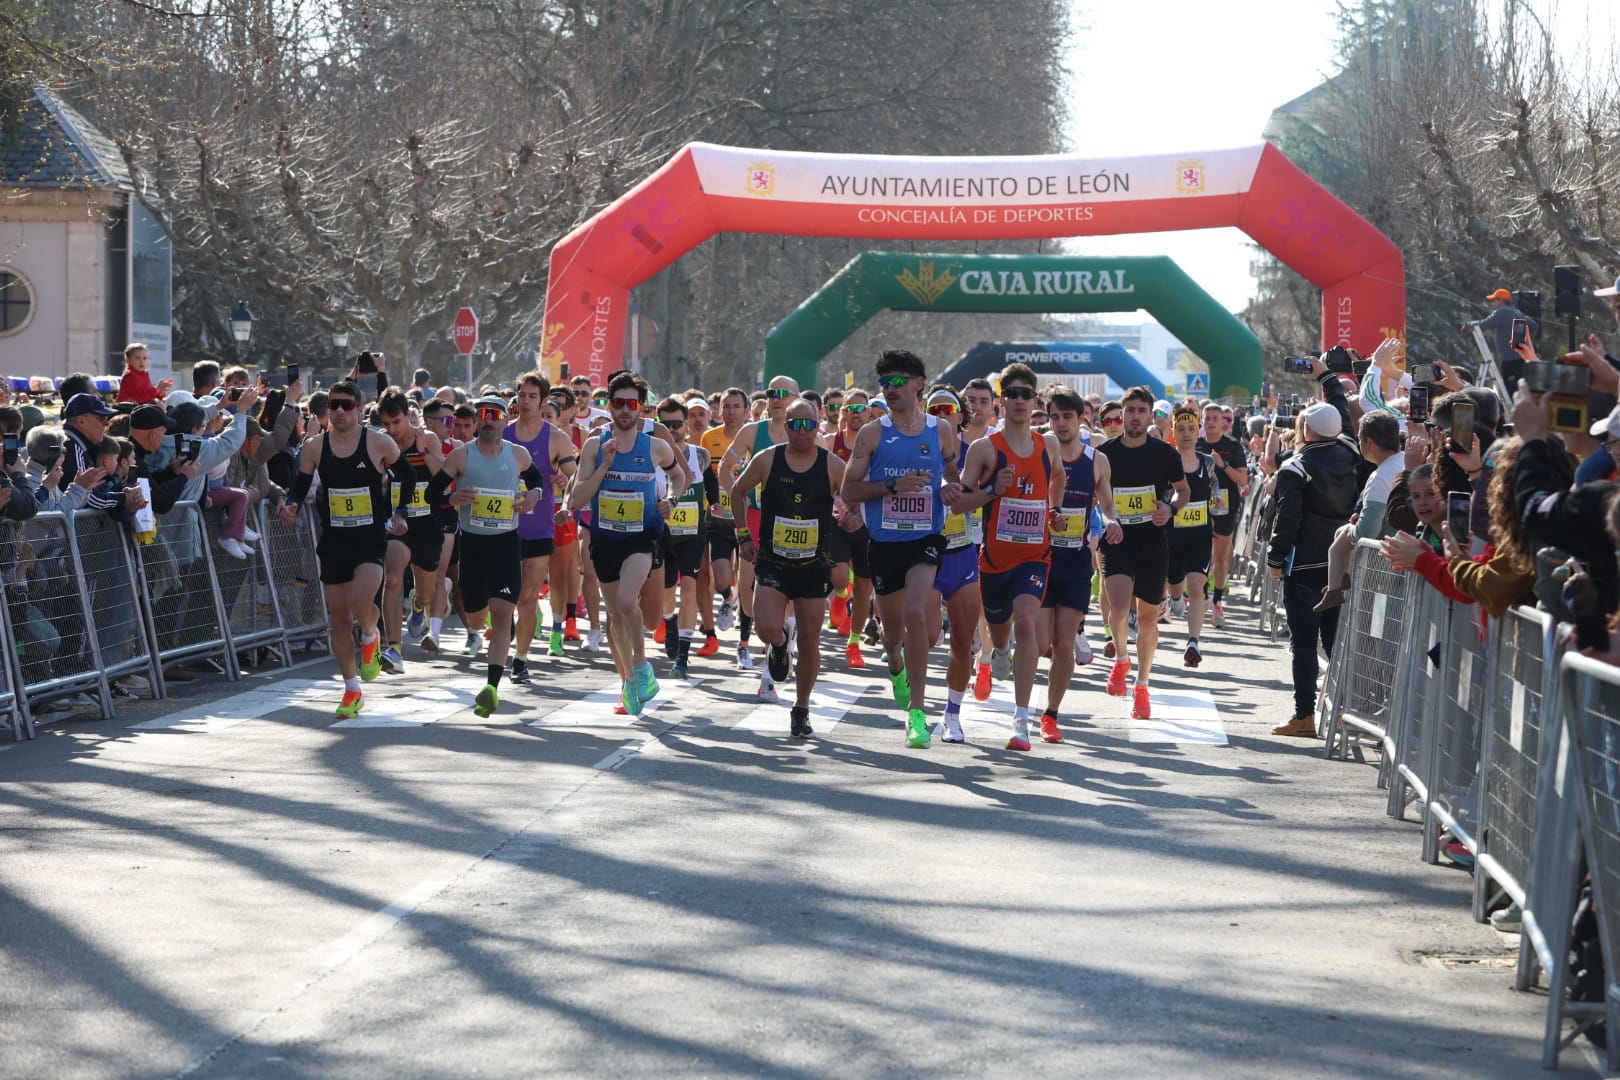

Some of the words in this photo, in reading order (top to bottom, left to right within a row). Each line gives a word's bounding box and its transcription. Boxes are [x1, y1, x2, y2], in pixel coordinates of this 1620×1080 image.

[821, 175, 1018, 197] AYUNTAMIENTO
[1027, 176, 1058, 196] DE
[1067, 169, 1130, 195] LEÓN
[858, 206, 967, 224] CONCEJALÍA
[974, 209, 997, 223] DE
[1004, 207, 1093, 223] DEPORTES
[959, 270, 1031, 296] CAJA
[1033, 269, 1135, 295] RURAL
[456, 326, 474, 337] STOP
[588, 296, 611, 387] DEPORTES
[1005, 352, 1092, 363] POWERADE
[345, 498, 354, 512] 8
[486, 499, 502, 514] 42
[617, 503, 625, 517] 4
[891, 496, 925, 512] 3009
[1128, 497, 1143, 510] 48
[672, 511, 686, 523] 43
[1007, 509, 1040, 527] 3008
[1183, 510, 1201, 522] 449
[784, 529, 808, 544] 290
